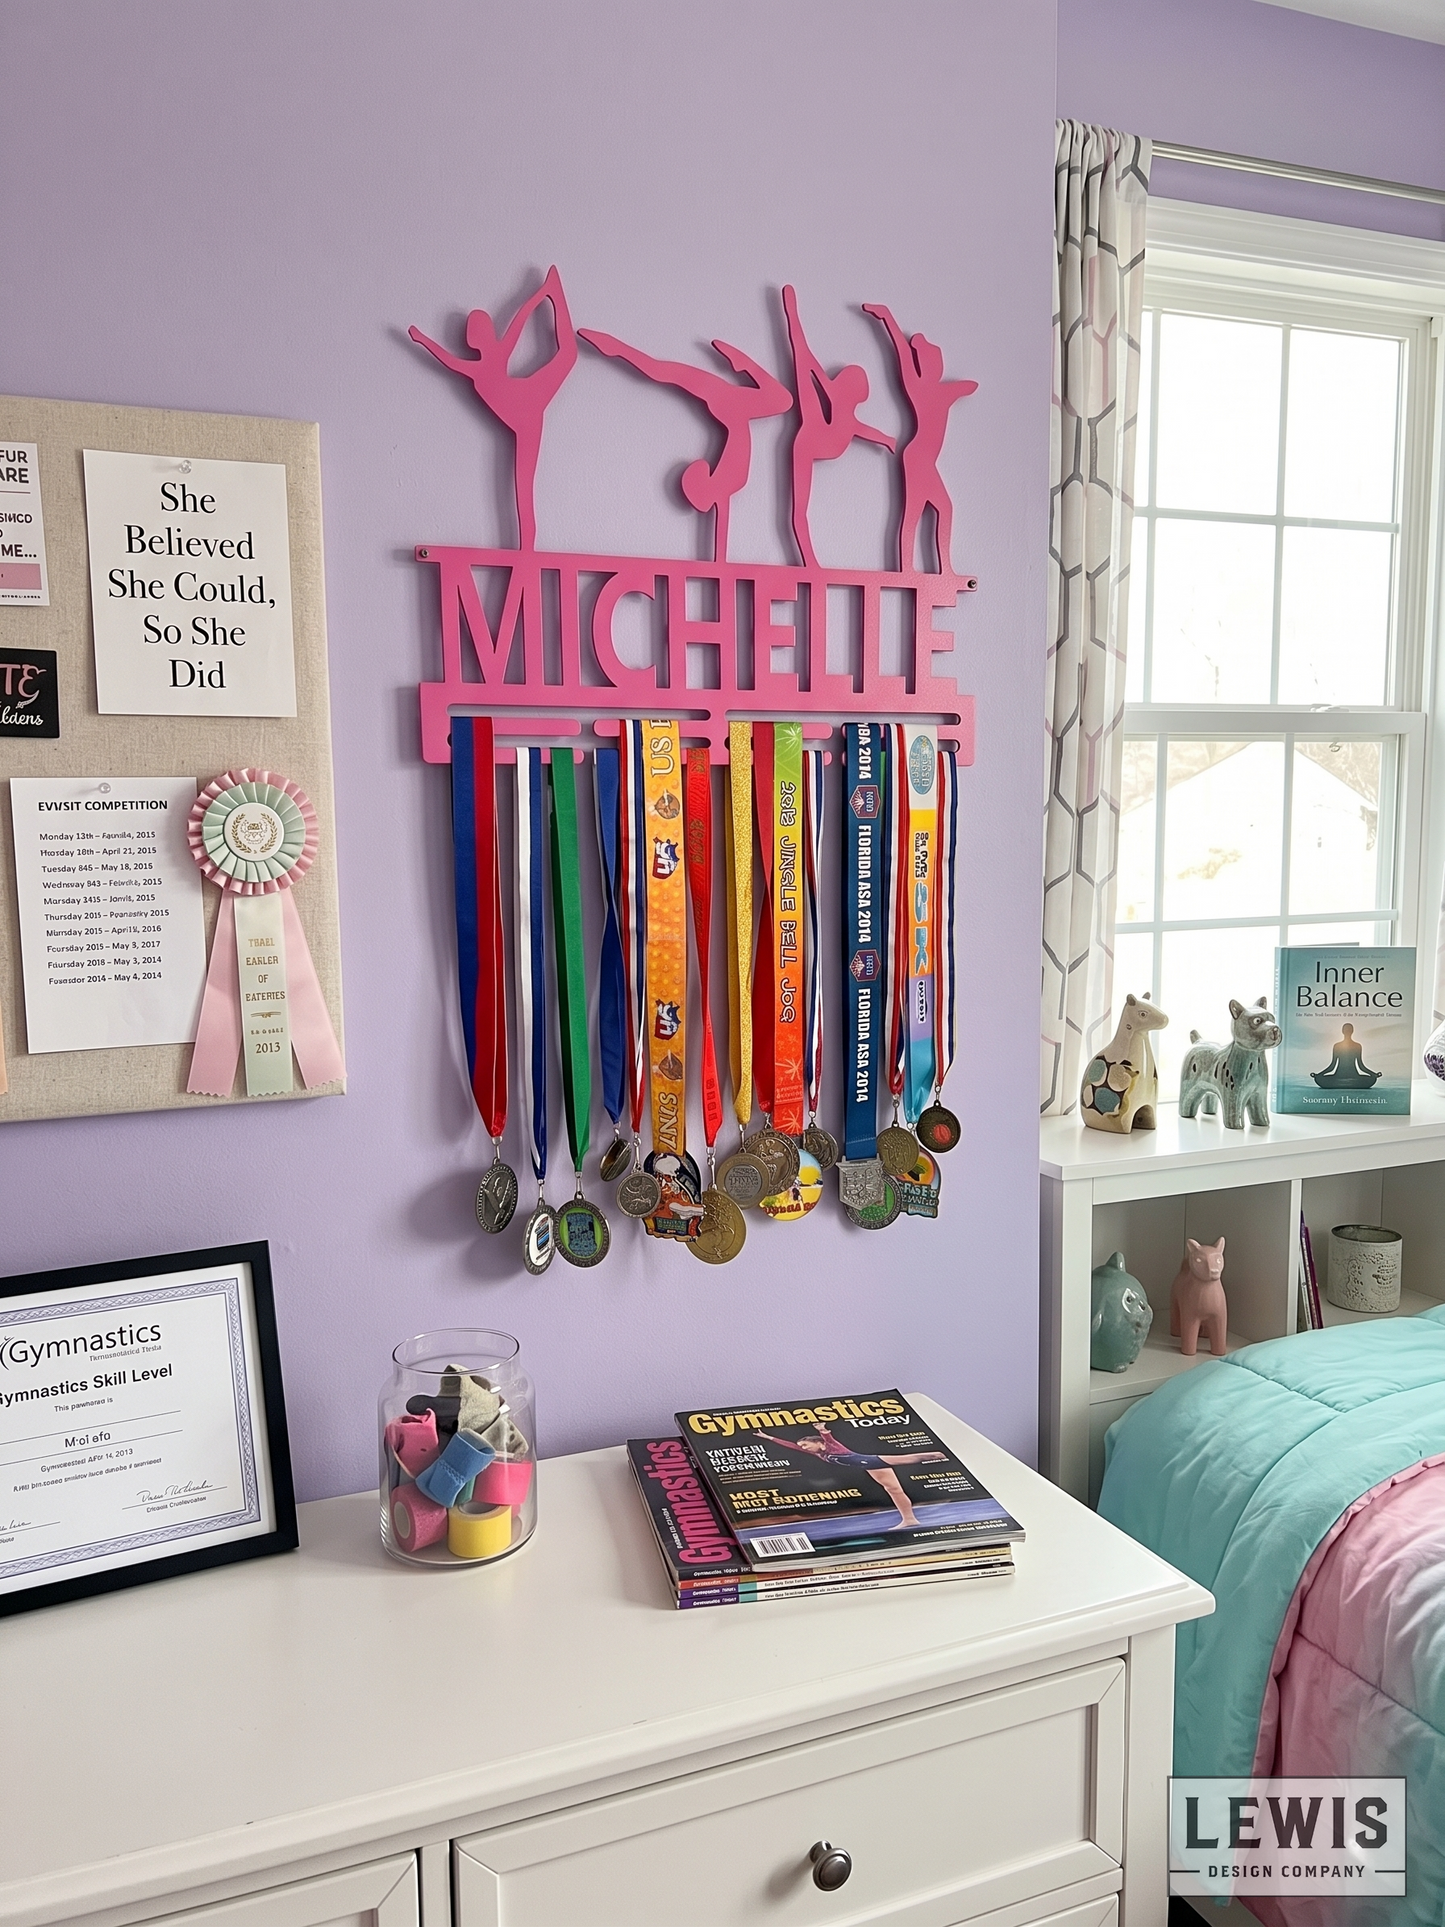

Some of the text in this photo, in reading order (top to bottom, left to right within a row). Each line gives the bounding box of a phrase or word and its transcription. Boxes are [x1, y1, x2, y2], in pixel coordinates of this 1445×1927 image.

[160, 482, 216, 513] She
[124, 524, 255, 560] Believed
[108, 568, 276, 609] She Could,
[143, 615, 246, 646] So She
[440, 562, 958, 695] MICHELLE
[169, 659, 226, 689] Did
[85, 800, 168, 810] COMPETITION
[39, 833, 74, 841] Monday
[76, 832, 94, 840] 13th
[136, 831, 156, 839] 2015
[102, 848, 121, 857] April
[137, 846, 157, 854] 2015
[857, 824, 872, 879] FLORIDA
[41, 865, 76, 873] Tuesday
[101, 863, 118, 872] May
[133, 862, 153, 870] 2015
[779, 835, 797, 912] JINGLE
[142, 878, 162, 886] 2015
[136, 894, 156, 902] 2015
[857, 882, 872, 908] ASA
[44, 913, 82, 921] Thursday
[150, 909, 170, 917] 2015
[84, 927, 103, 936] 2015
[142, 925, 162, 933] 2016
[857, 911, 872, 944] 2014
[112, 942, 130, 950] May
[780, 920, 797, 969] BELL
[113, 958, 130, 966] May
[142, 956, 162, 964] 2014
[1316, 961, 1384, 983] Inner
[114, 973, 131, 982] May
[258, 974, 269, 984] OF
[1297, 984, 1403, 1008] Balance
[858, 988, 870, 1041] FLORIDA
[255, 1042, 281, 1054] 2013
[857, 1045, 869, 1070] ASA
[856, 1072, 869, 1103] 2014
[9, 1324, 161, 1368] Gymnastics
[93, 1370, 127, 1389] Skill
[132, 1363, 173, 1382] Level
[54, 1405, 70, 1413] This
[688, 1399, 905, 1437] Gymnastics
[845, 1414, 910, 1429] Today
[115, 1448, 133, 1458] 2013
[645, 1442, 736, 1565] Gymnastics
